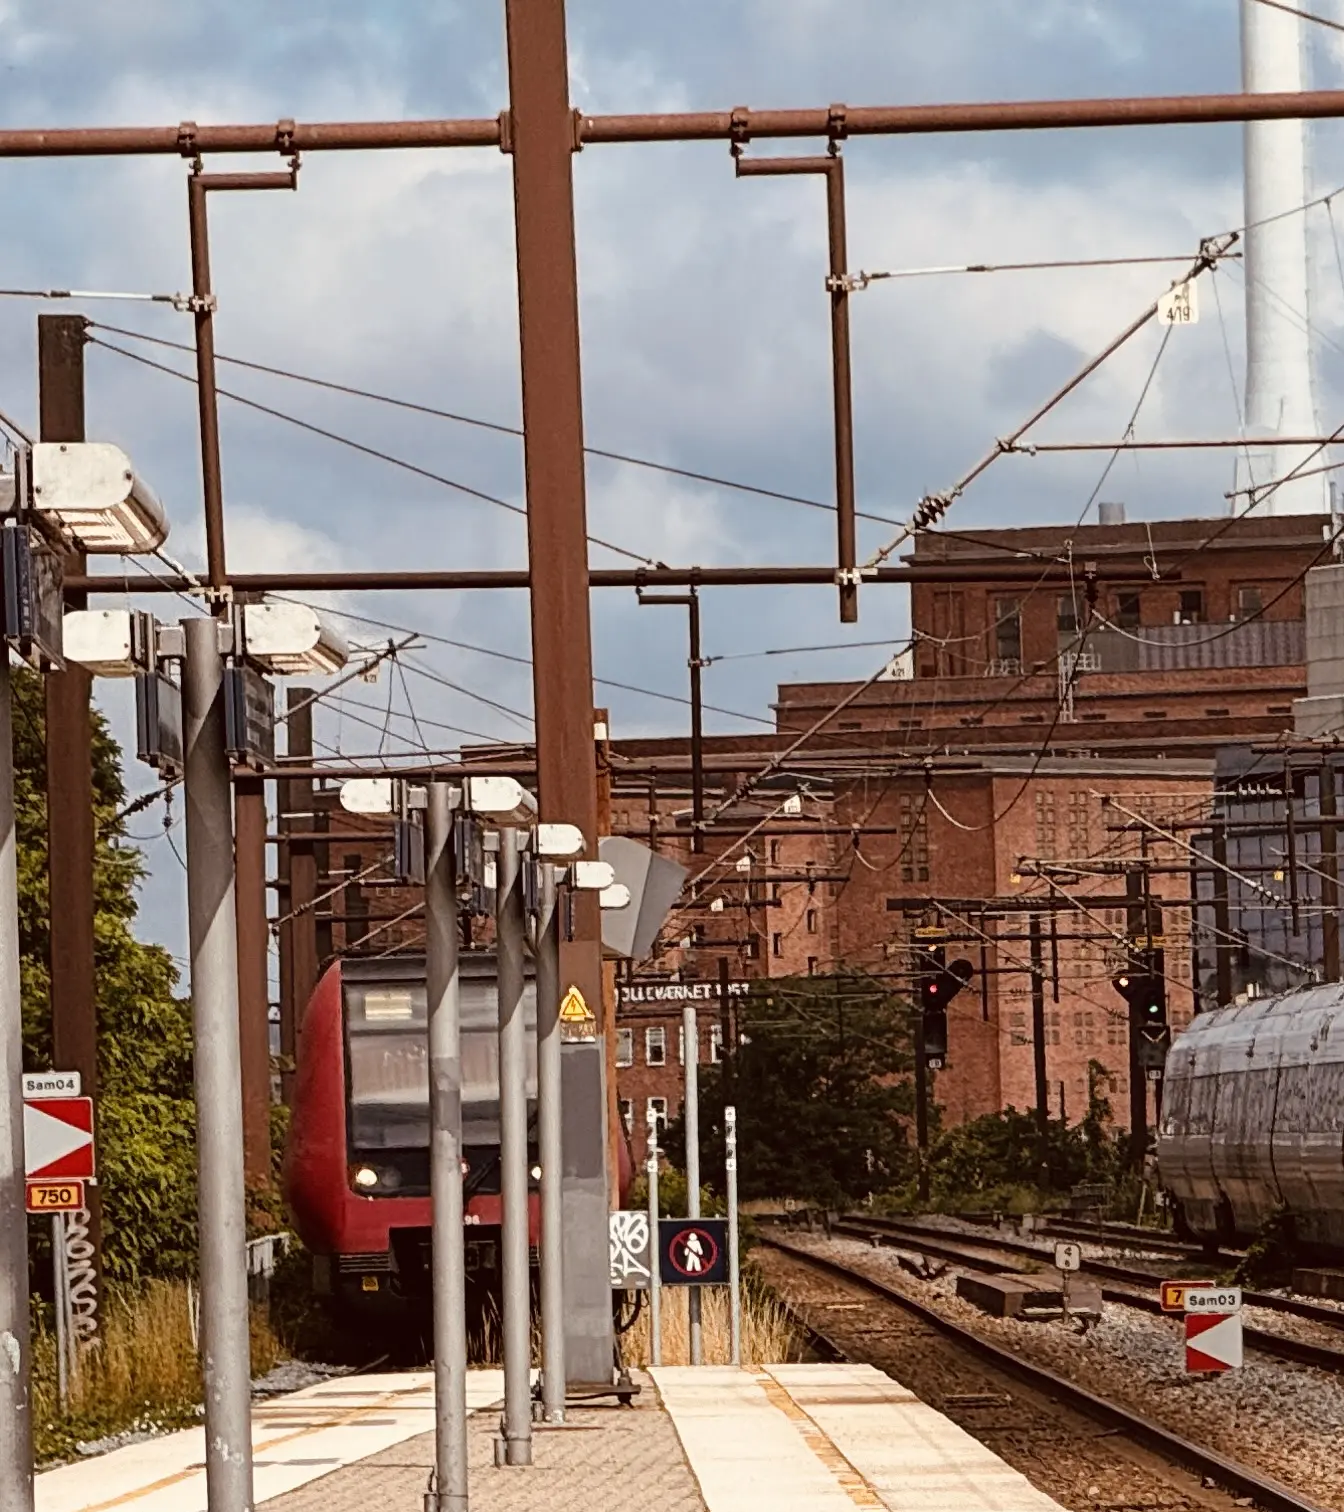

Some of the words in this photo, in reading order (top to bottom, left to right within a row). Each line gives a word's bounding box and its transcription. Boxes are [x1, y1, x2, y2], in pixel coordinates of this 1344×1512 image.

[26, 1079, 75, 1091] Sam04
[37, 1188, 72, 1204] 750
[1189, 1295, 1236, 1306] Sam03
